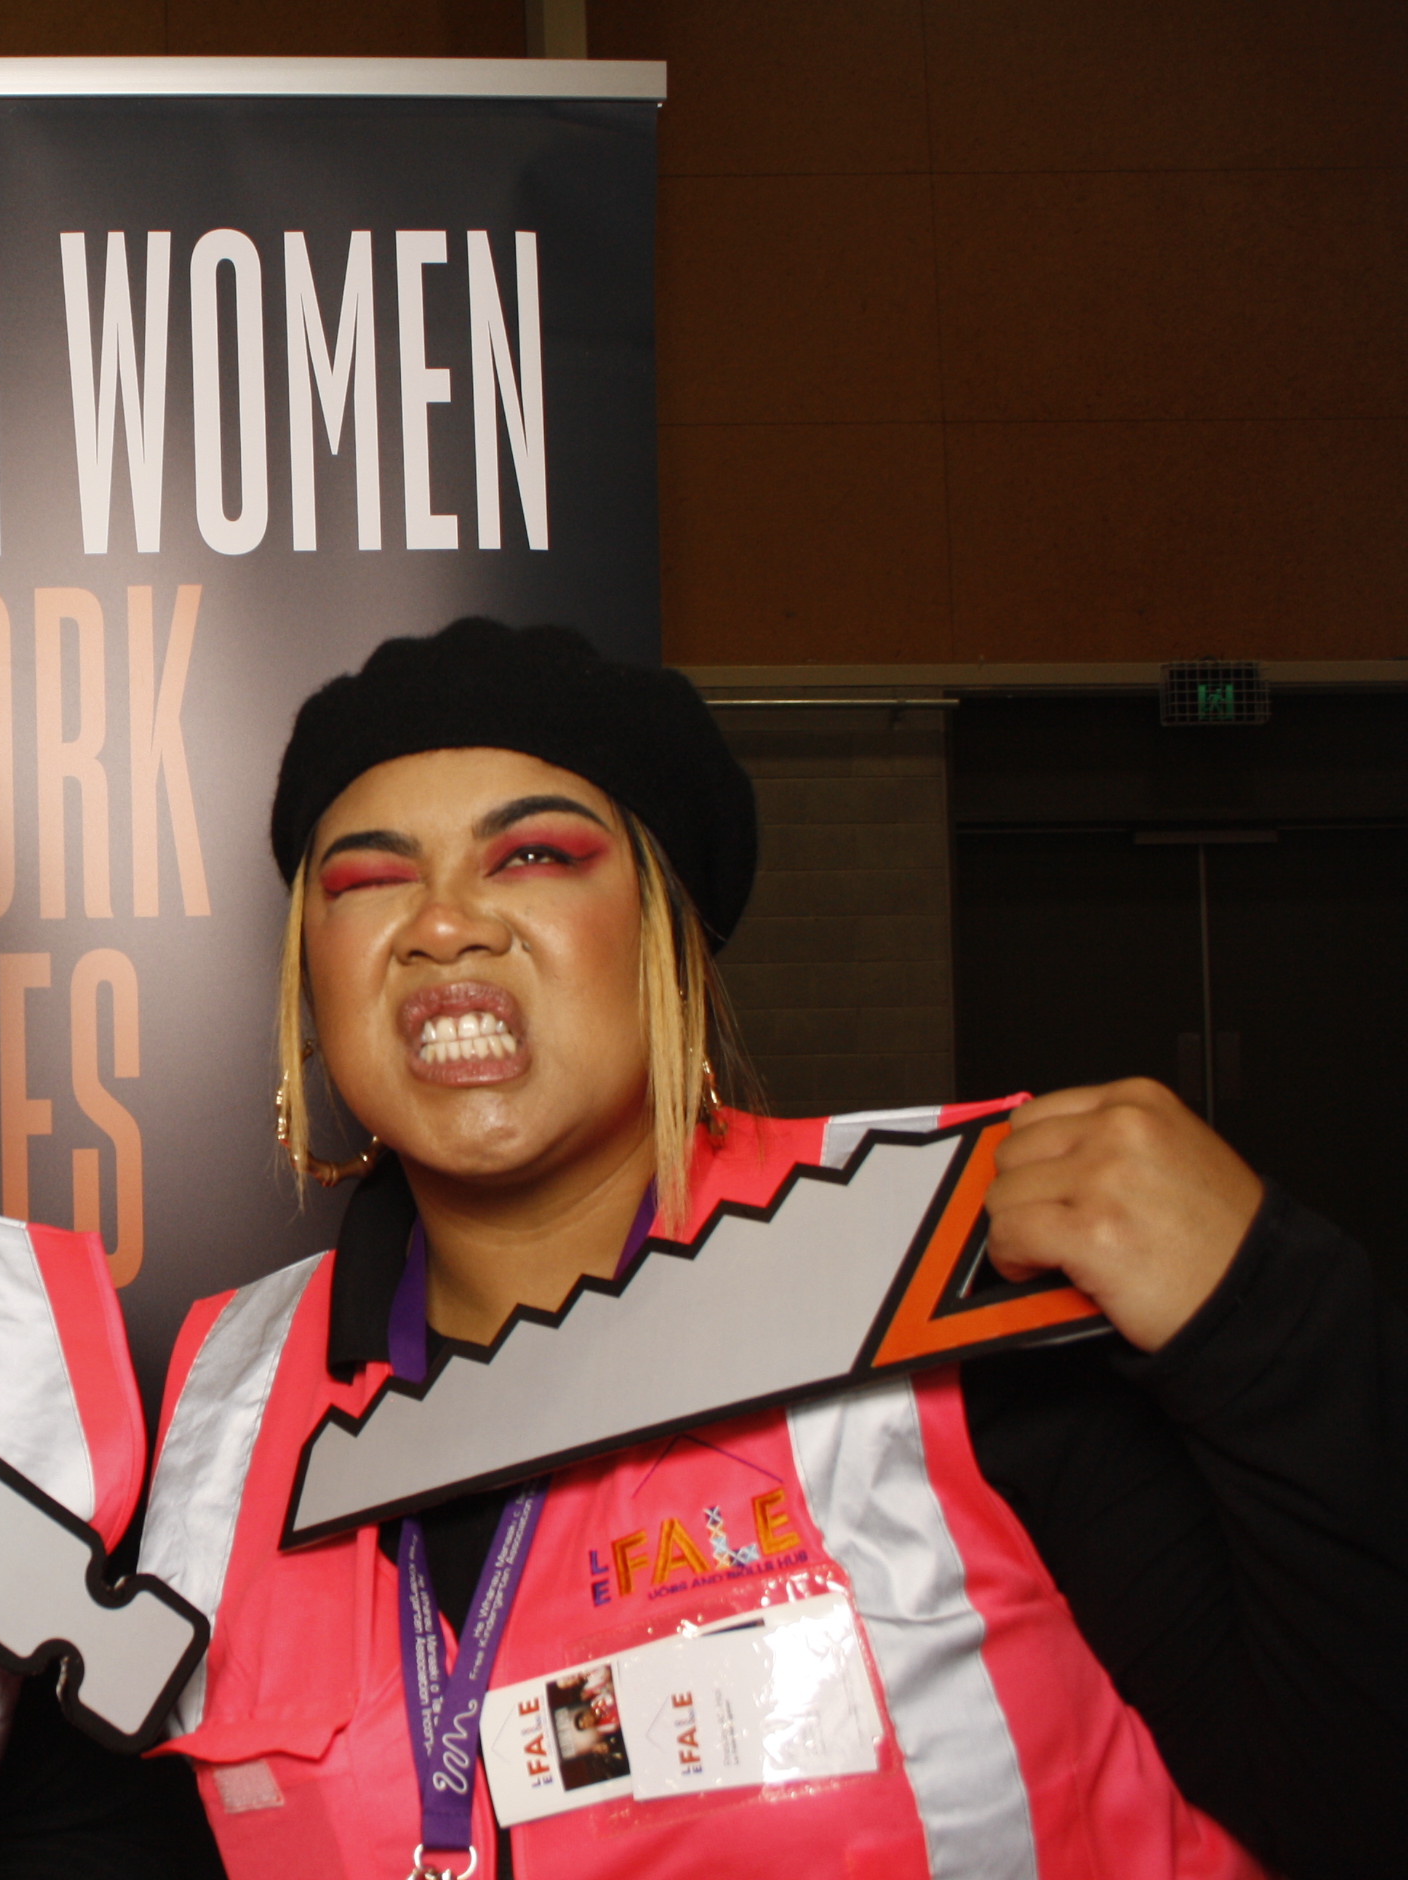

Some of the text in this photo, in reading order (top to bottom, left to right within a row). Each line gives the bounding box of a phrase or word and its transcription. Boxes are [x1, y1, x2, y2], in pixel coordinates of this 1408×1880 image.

[60, 228, 549, 555] WOMEN
[611, 1487, 801, 1597] FALE
[648, 1550, 809, 1600] JOBS AND SKILLS HUB
[469, 1650, 484, 1680] Free
[479, 1566, 511, 1648] Kindergarten
[505, 1498, 533, 1565] Association
[415, 1635, 429, 1705] Association
[518, 1697, 550, 1777] FALE
[671, 1691, 701, 1765] FALE
